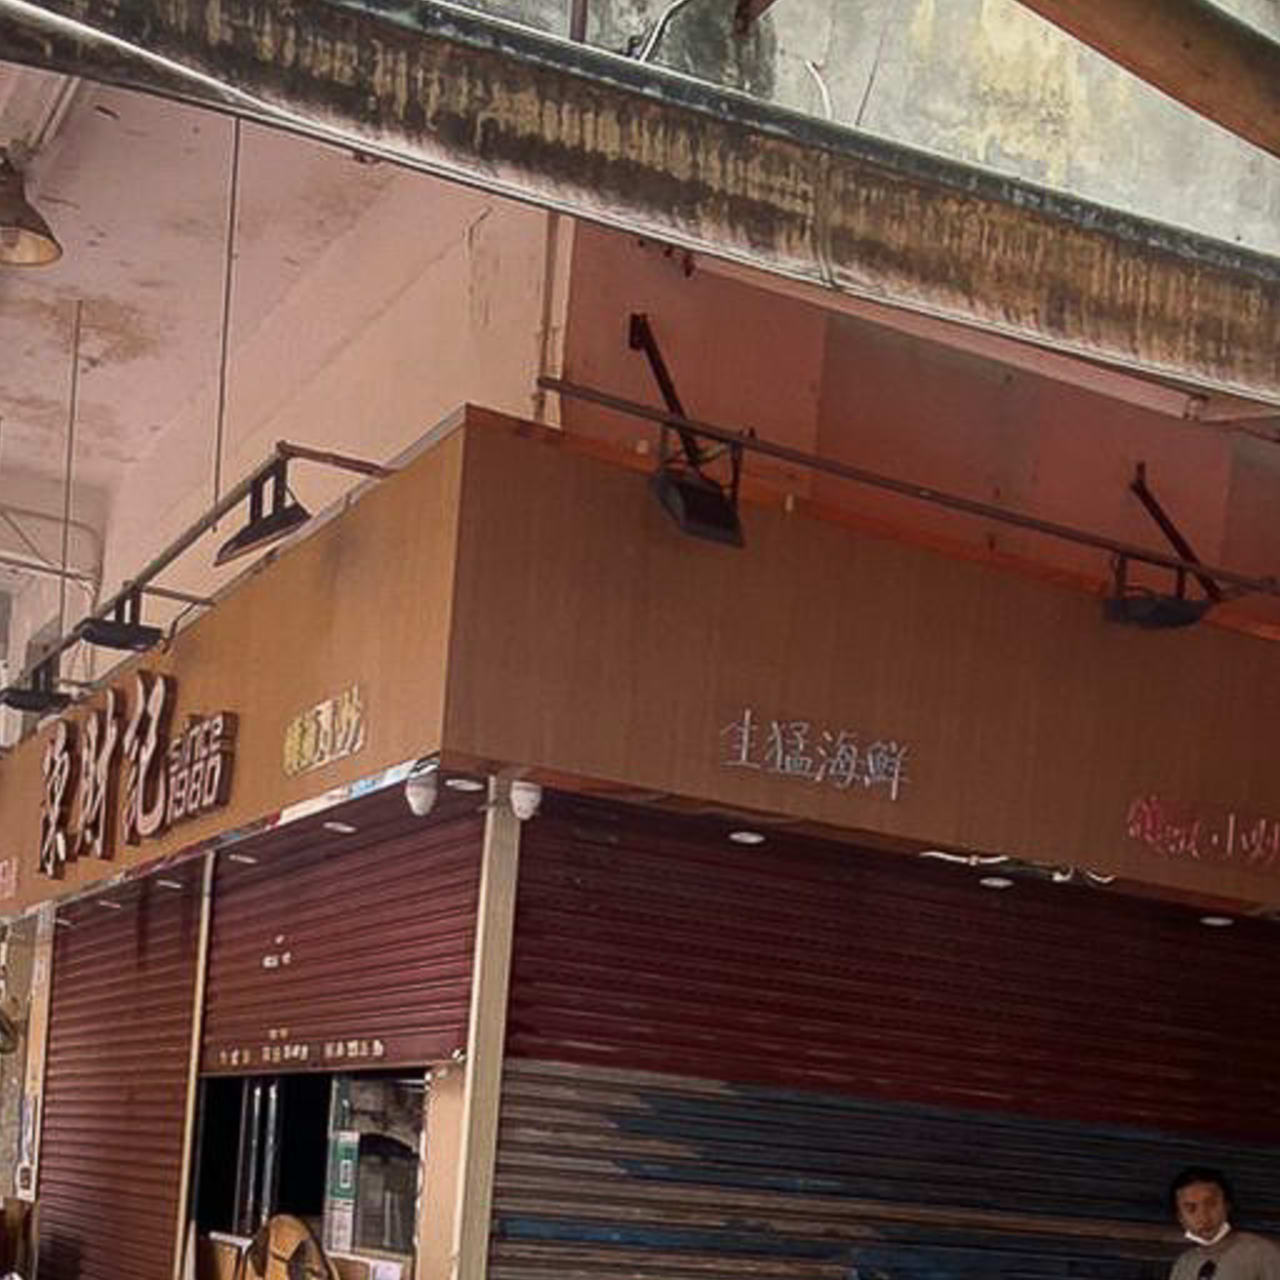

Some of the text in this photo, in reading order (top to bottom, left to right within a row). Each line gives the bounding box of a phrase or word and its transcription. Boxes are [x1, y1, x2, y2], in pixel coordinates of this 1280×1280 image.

[170, 714, 225, 774] since
[720, 707, 912, 801] 生猛海鮮
[167, 753, 224, 827] 1980
